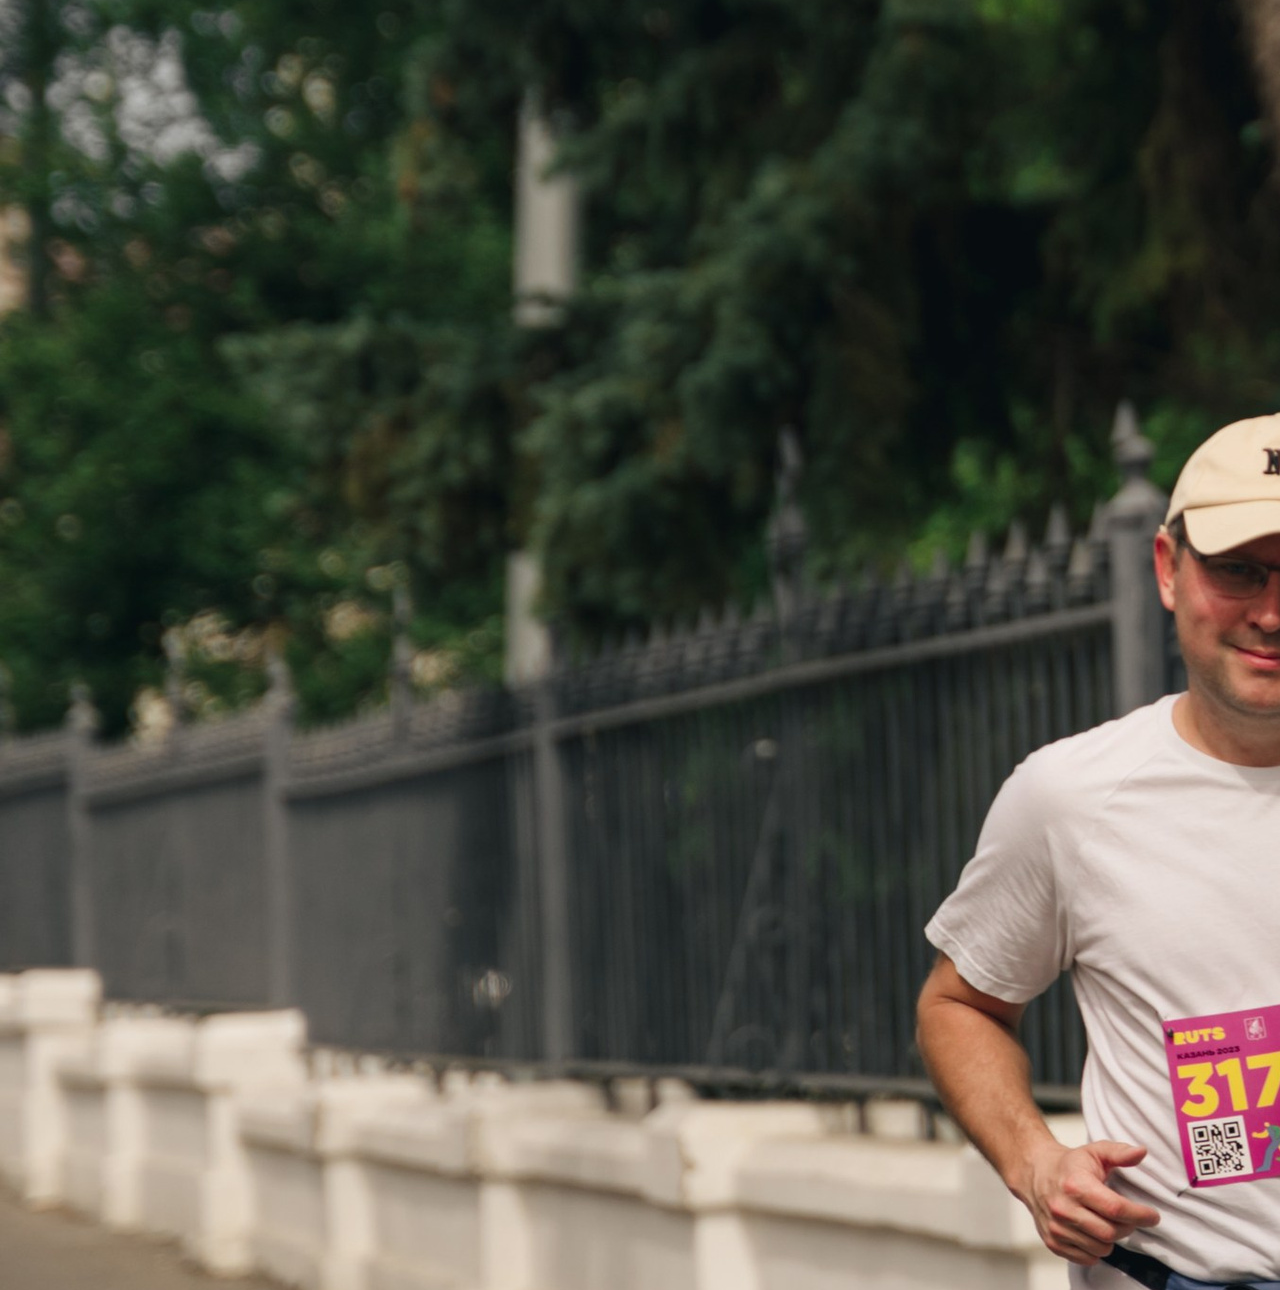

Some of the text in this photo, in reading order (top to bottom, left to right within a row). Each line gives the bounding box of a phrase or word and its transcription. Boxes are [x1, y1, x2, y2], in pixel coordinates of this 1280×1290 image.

[1173, 1026, 1226, 1045] RUTS
[1176, 1045, 1240, 1059] КАЗАНЬ 2023
